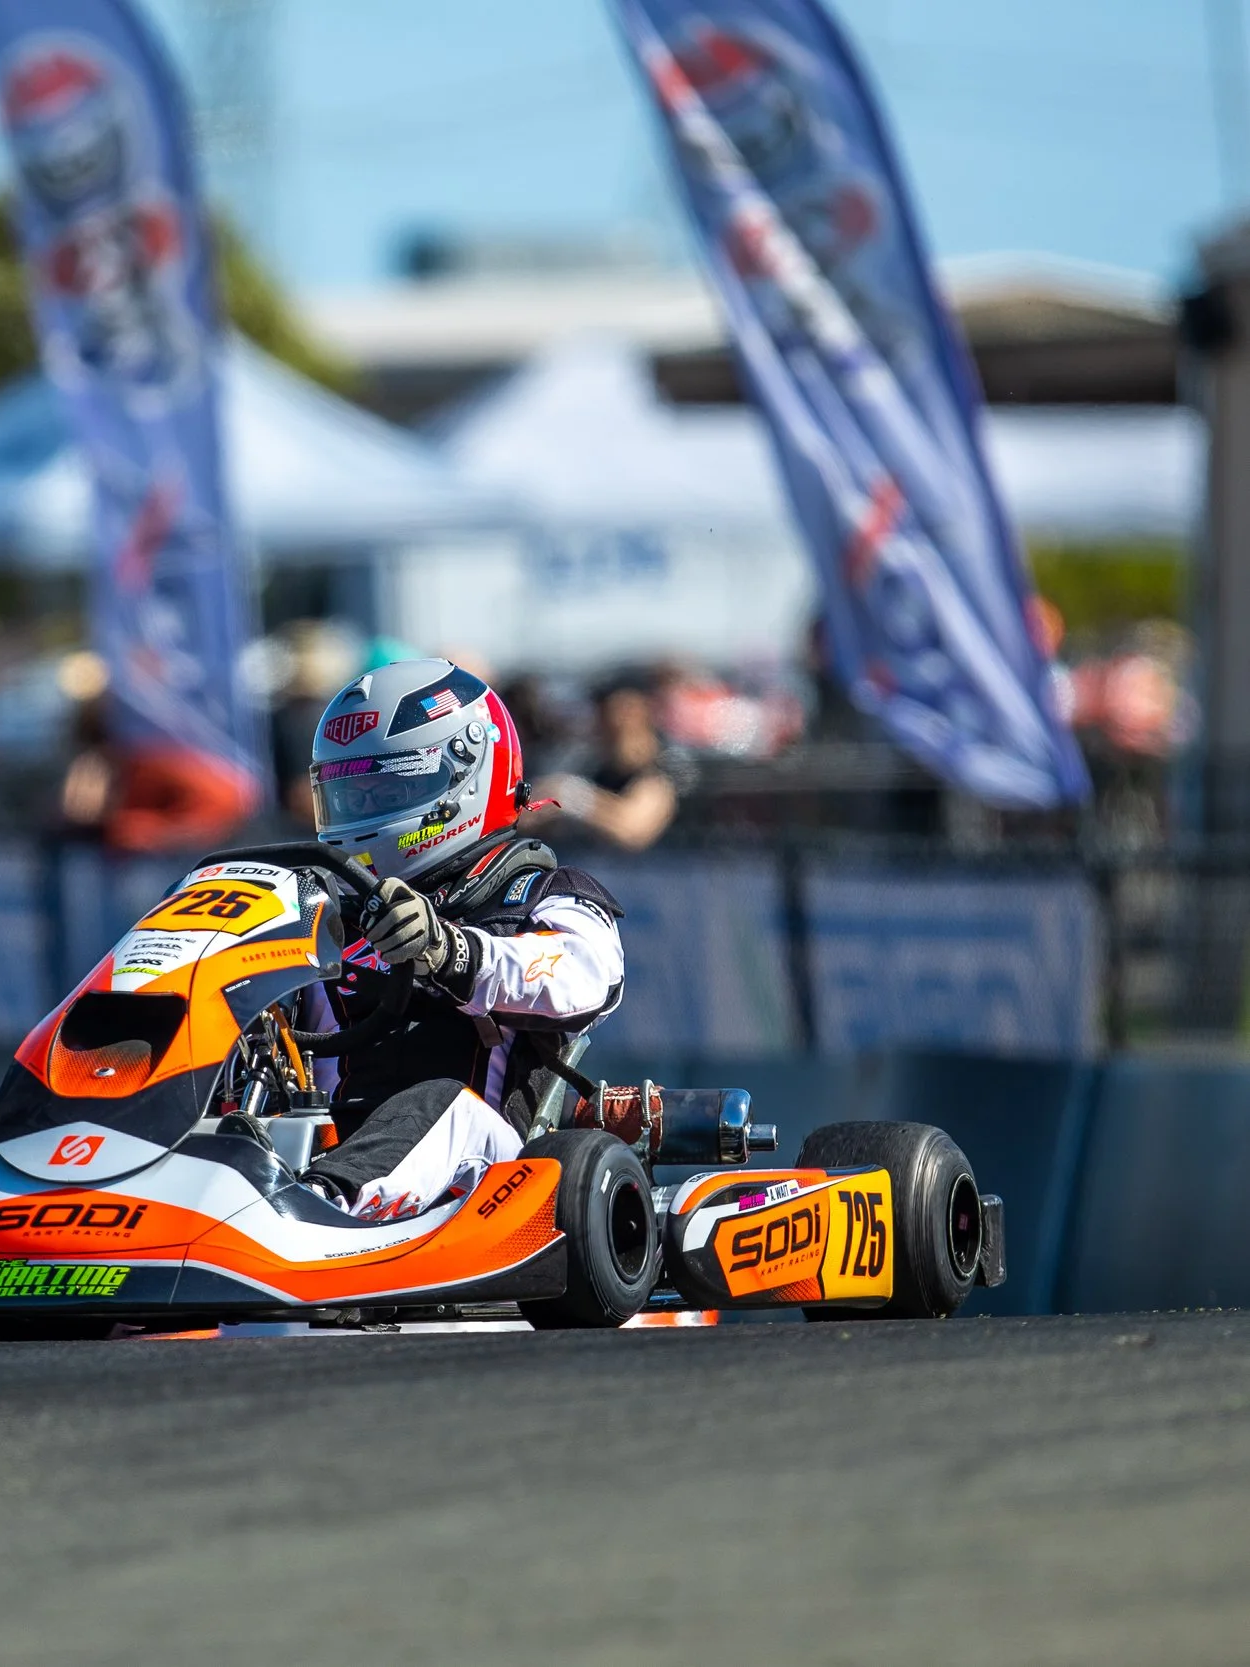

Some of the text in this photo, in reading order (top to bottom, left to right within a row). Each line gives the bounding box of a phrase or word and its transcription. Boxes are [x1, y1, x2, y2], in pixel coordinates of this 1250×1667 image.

[325, 712, 375, 743] HEUER
[405, 813, 482, 859] ANDREW
[147, 889, 262, 919] 725
[241, 947, 302, 964] KART RACING
[775, 1184, 790, 1200] WAIT
[23, 1229, 132, 1238] KART RACING
[838, 1190, 887, 1278] 725
[761, 1249, 820, 1277] KART RACING
